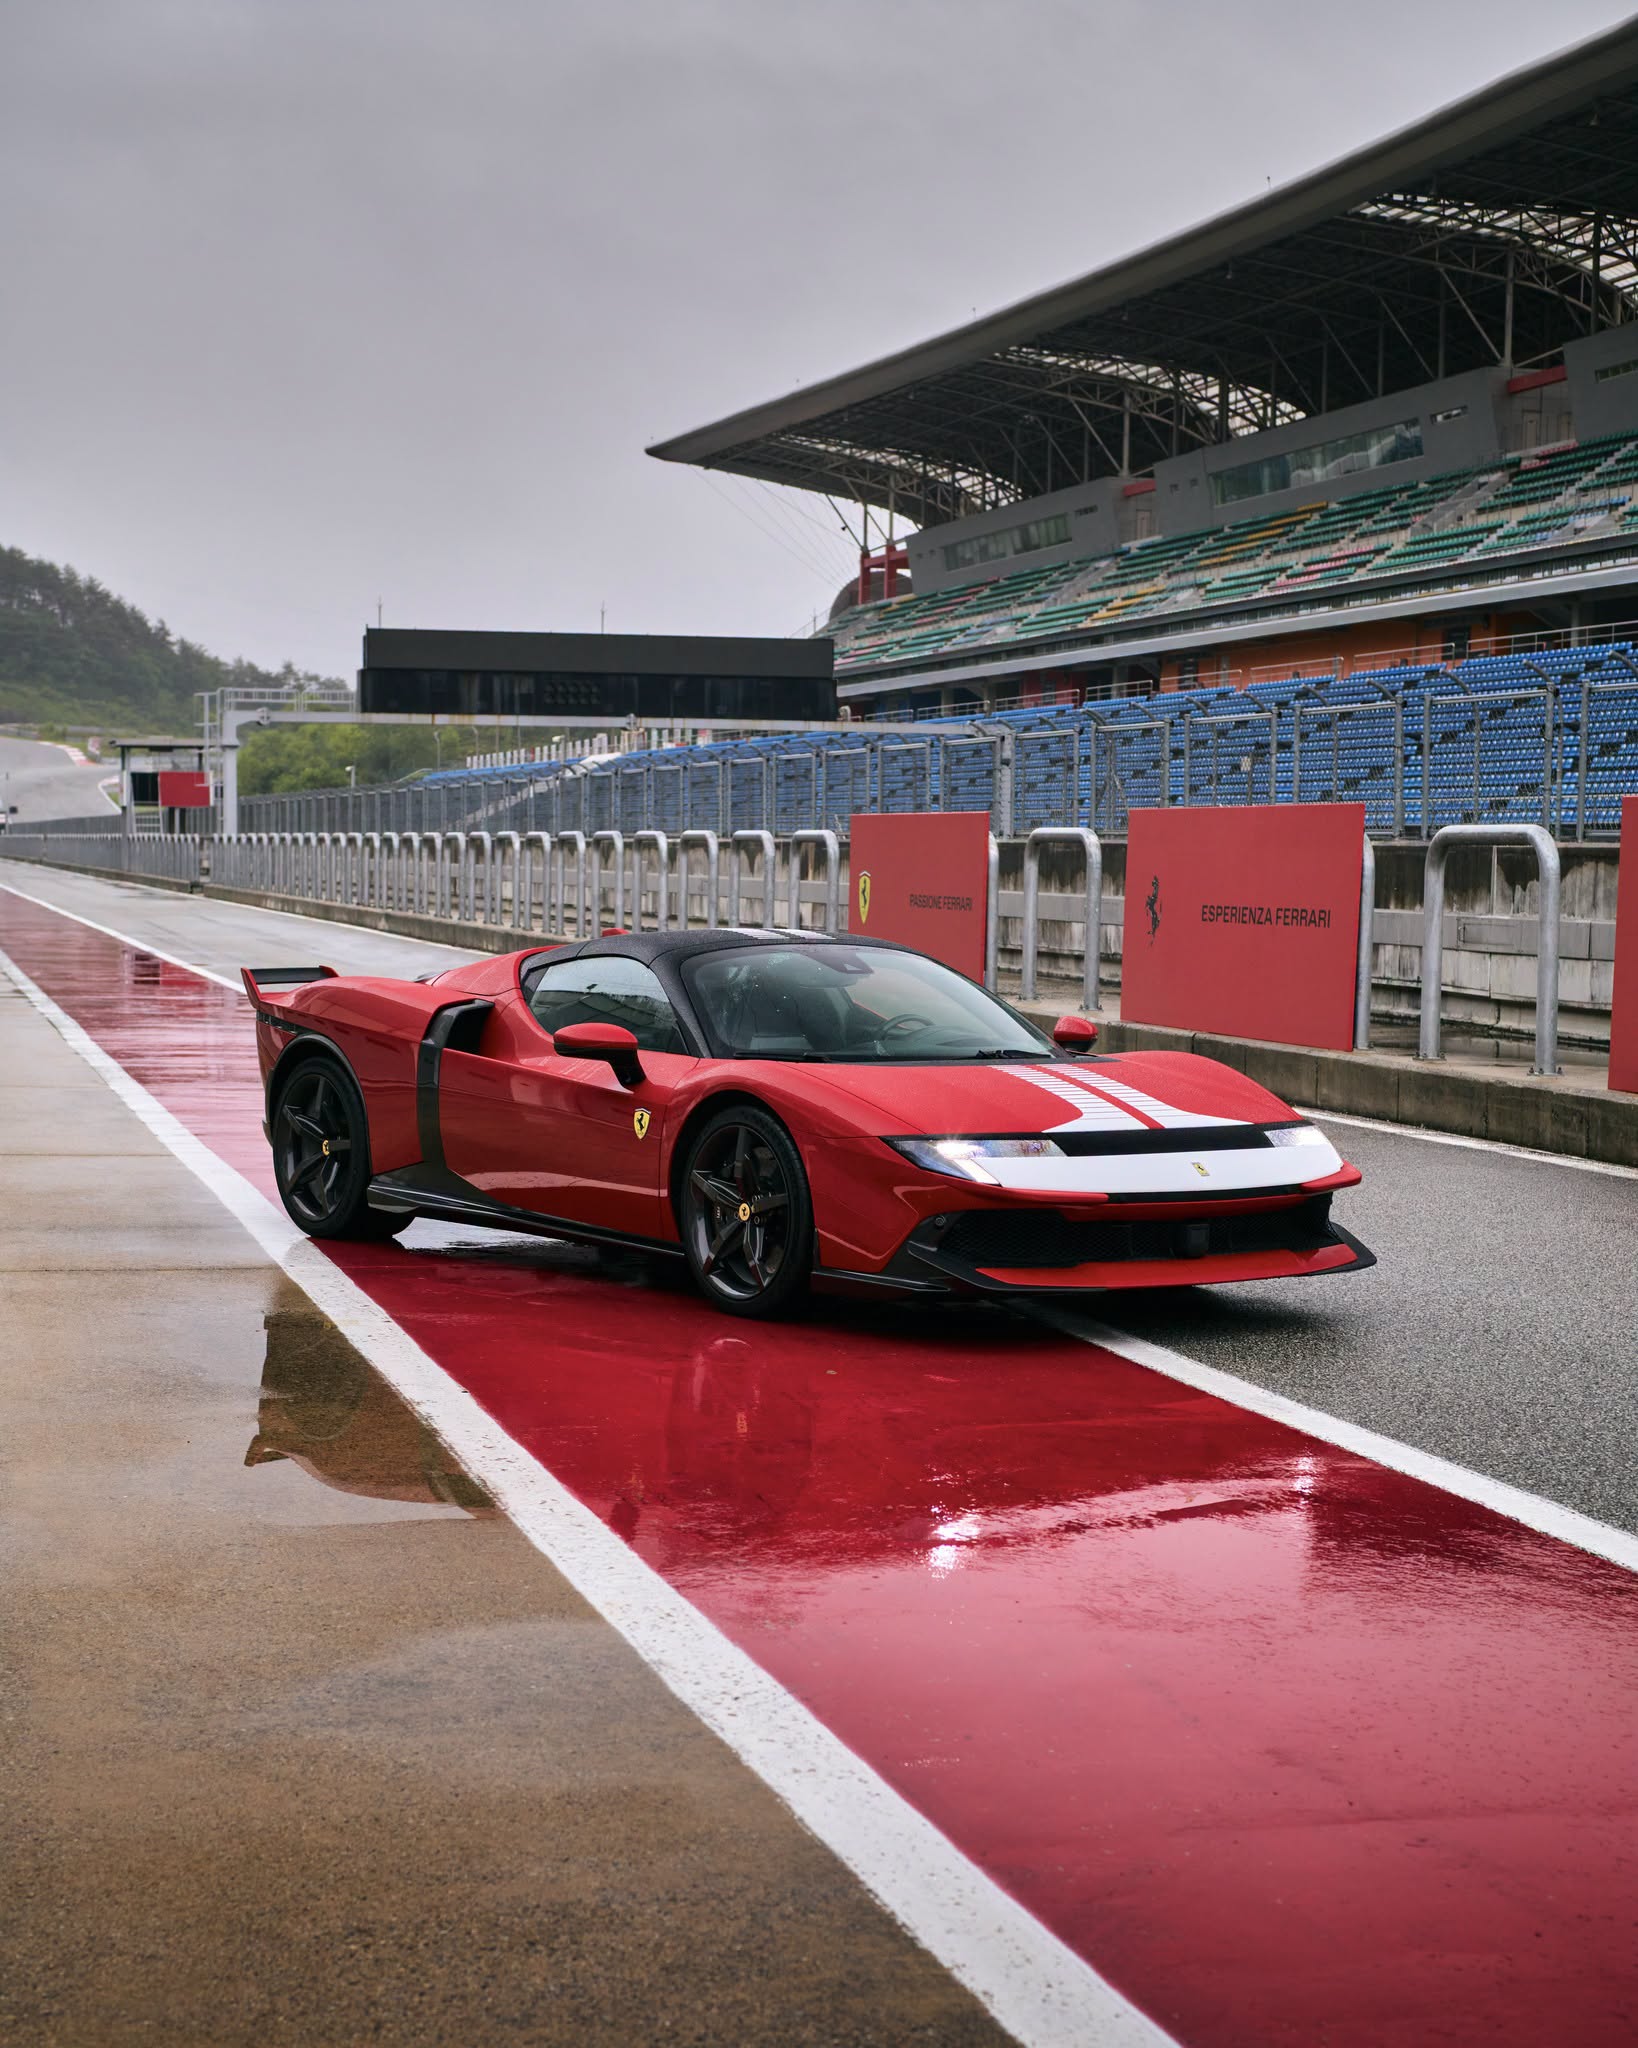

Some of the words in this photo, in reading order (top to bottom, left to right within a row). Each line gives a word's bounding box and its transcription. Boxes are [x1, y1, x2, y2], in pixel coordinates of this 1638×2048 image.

[909, 894, 942, 910] PASSIONE
[943, 896, 973, 911] FERRARI
[1201, 905, 1272, 925] ESPERIENZA
[1275, 907, 1331, 928] FERRARI
